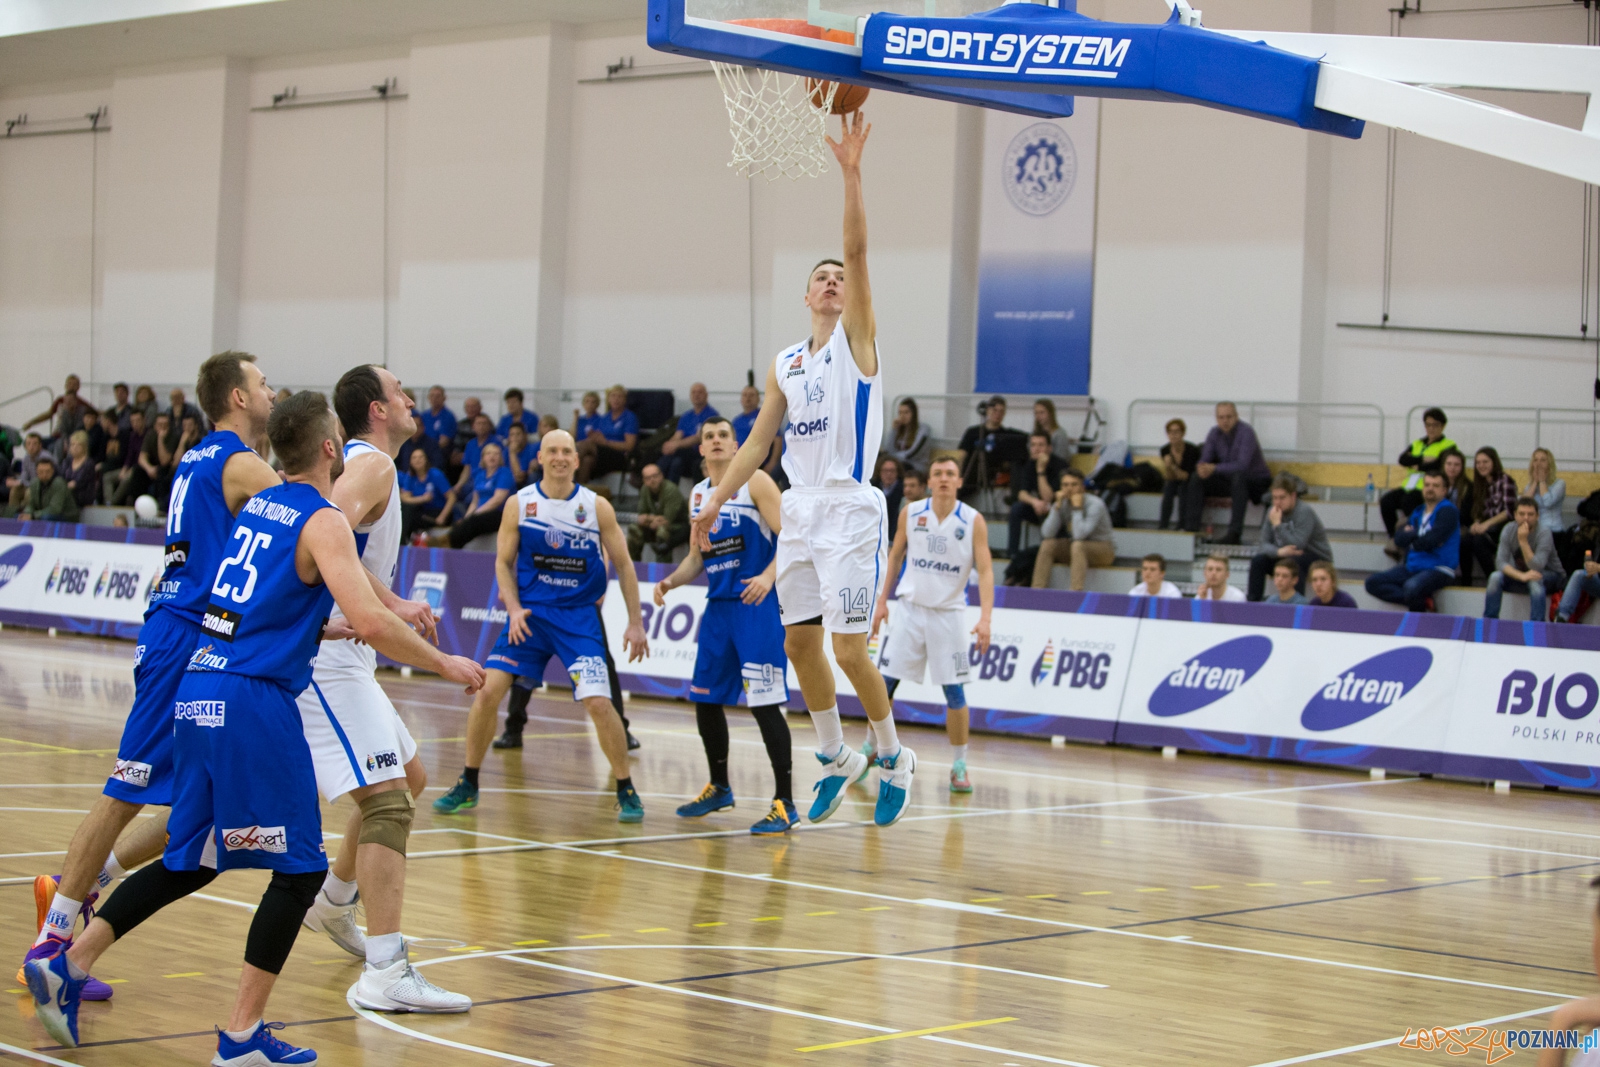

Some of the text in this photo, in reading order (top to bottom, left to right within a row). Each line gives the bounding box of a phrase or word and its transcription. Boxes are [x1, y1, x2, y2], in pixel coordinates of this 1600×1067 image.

[885, 25, 1132, 73] SPORTSYSTEM
[786, 369, 806, 379] joma
[803, 376, 825, 406] 14
[261, 501, 302, 527] PRUDNIK
[729, 508, 741, 528] 9
[569, 530, 591, 550] 22
[926, 534, 947, 554] 16
[211, 525, 273, 604] 25
[57, 566, 89, 595] PBG
[105, 571, 139, 600] PBG
[839, 586, 870, 614] 14
[845, 615, 867, 624] joma
[762, 663, 774, 687] 9
[1053, 649, 1112, 690] PBG
[1168, 659, 1246, 692] atrem
[1323, 672, 1404, 705] atrem
[1512, 725, 1567, 741] POLSKI
[375, 752, 398, 769] PBG
